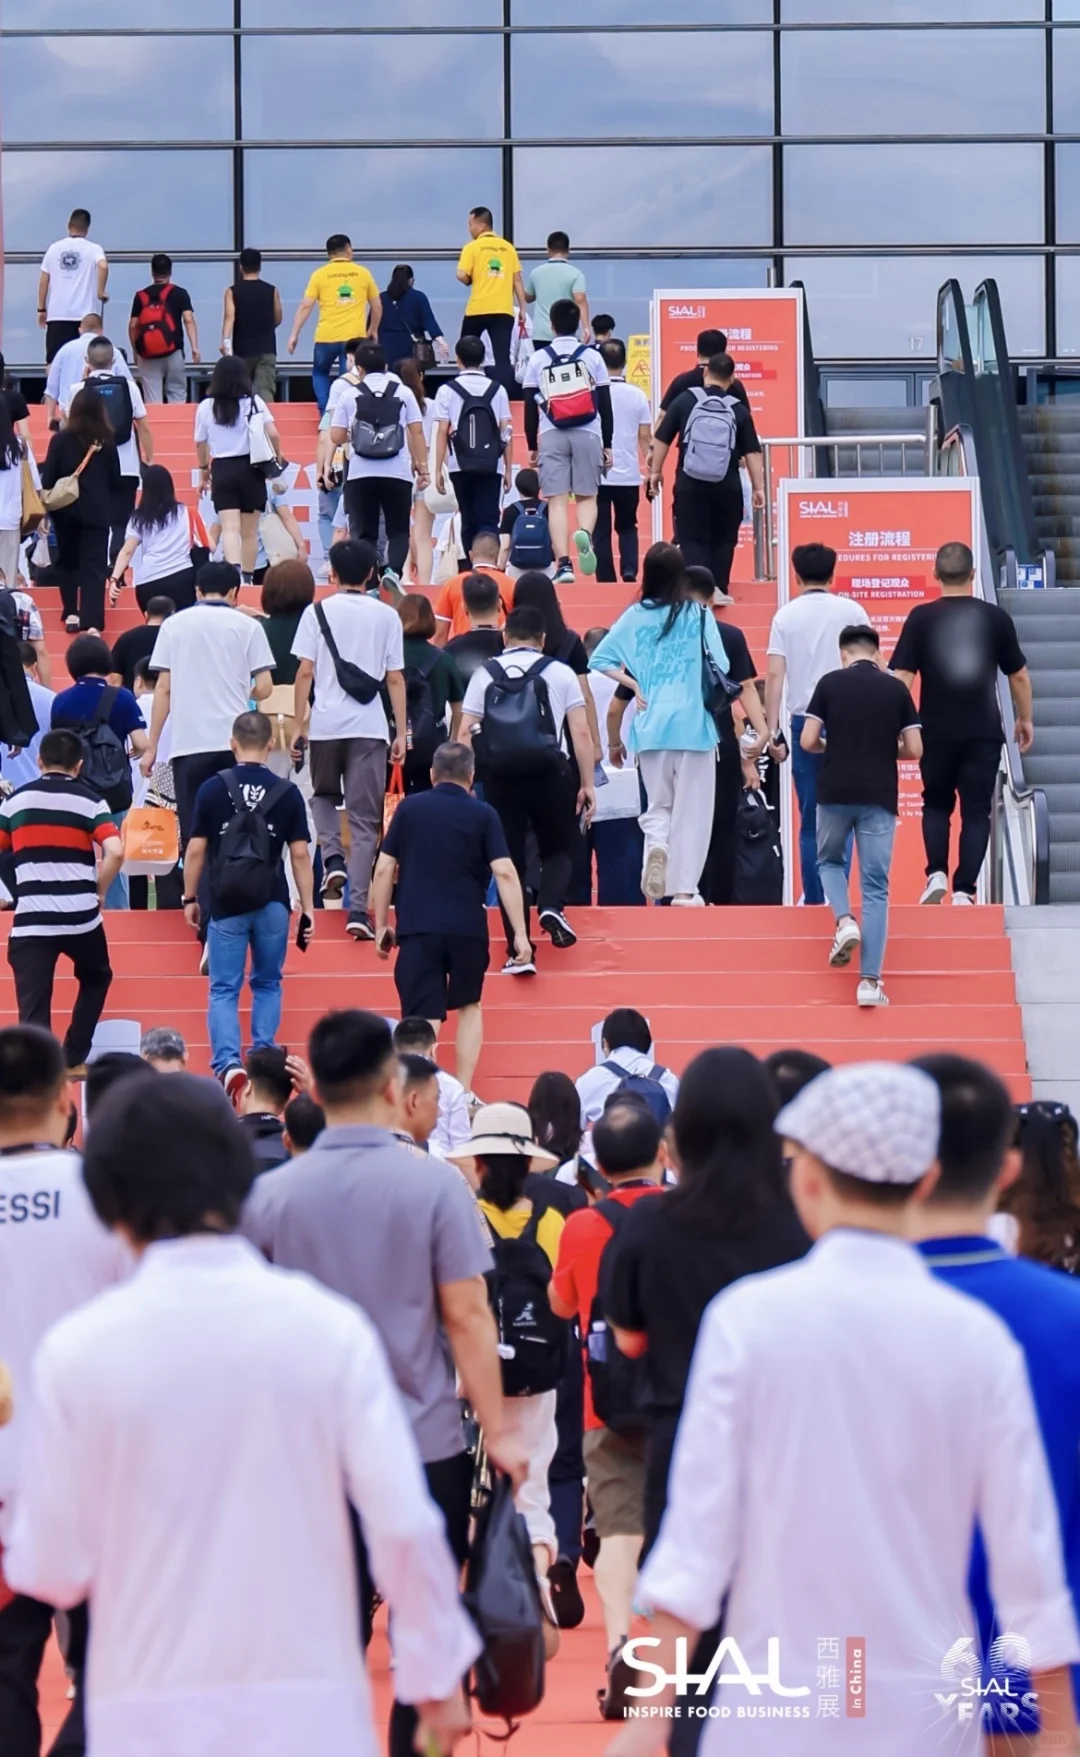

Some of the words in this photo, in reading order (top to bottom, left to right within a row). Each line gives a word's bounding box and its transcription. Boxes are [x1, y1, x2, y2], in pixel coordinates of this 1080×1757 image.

[668, 306, 697, 316] SIAL
[909, 337, 924, 350] 17
[799, 501, 837, 515] SIAL
[849, 531, 911, 547] 注册流程
[838, 553, 871, 562] EDURES
[873, 553, 889, 562] FOR
[892, 553, 938, 562] REGISTERI
[851, 577, 910, 589] 现场登记观众
[838, 591, 869, 599] ON-SITE
[870, 590, 925, 599] REGISTRATION
[0, 1190, 60, 1223] SSI
